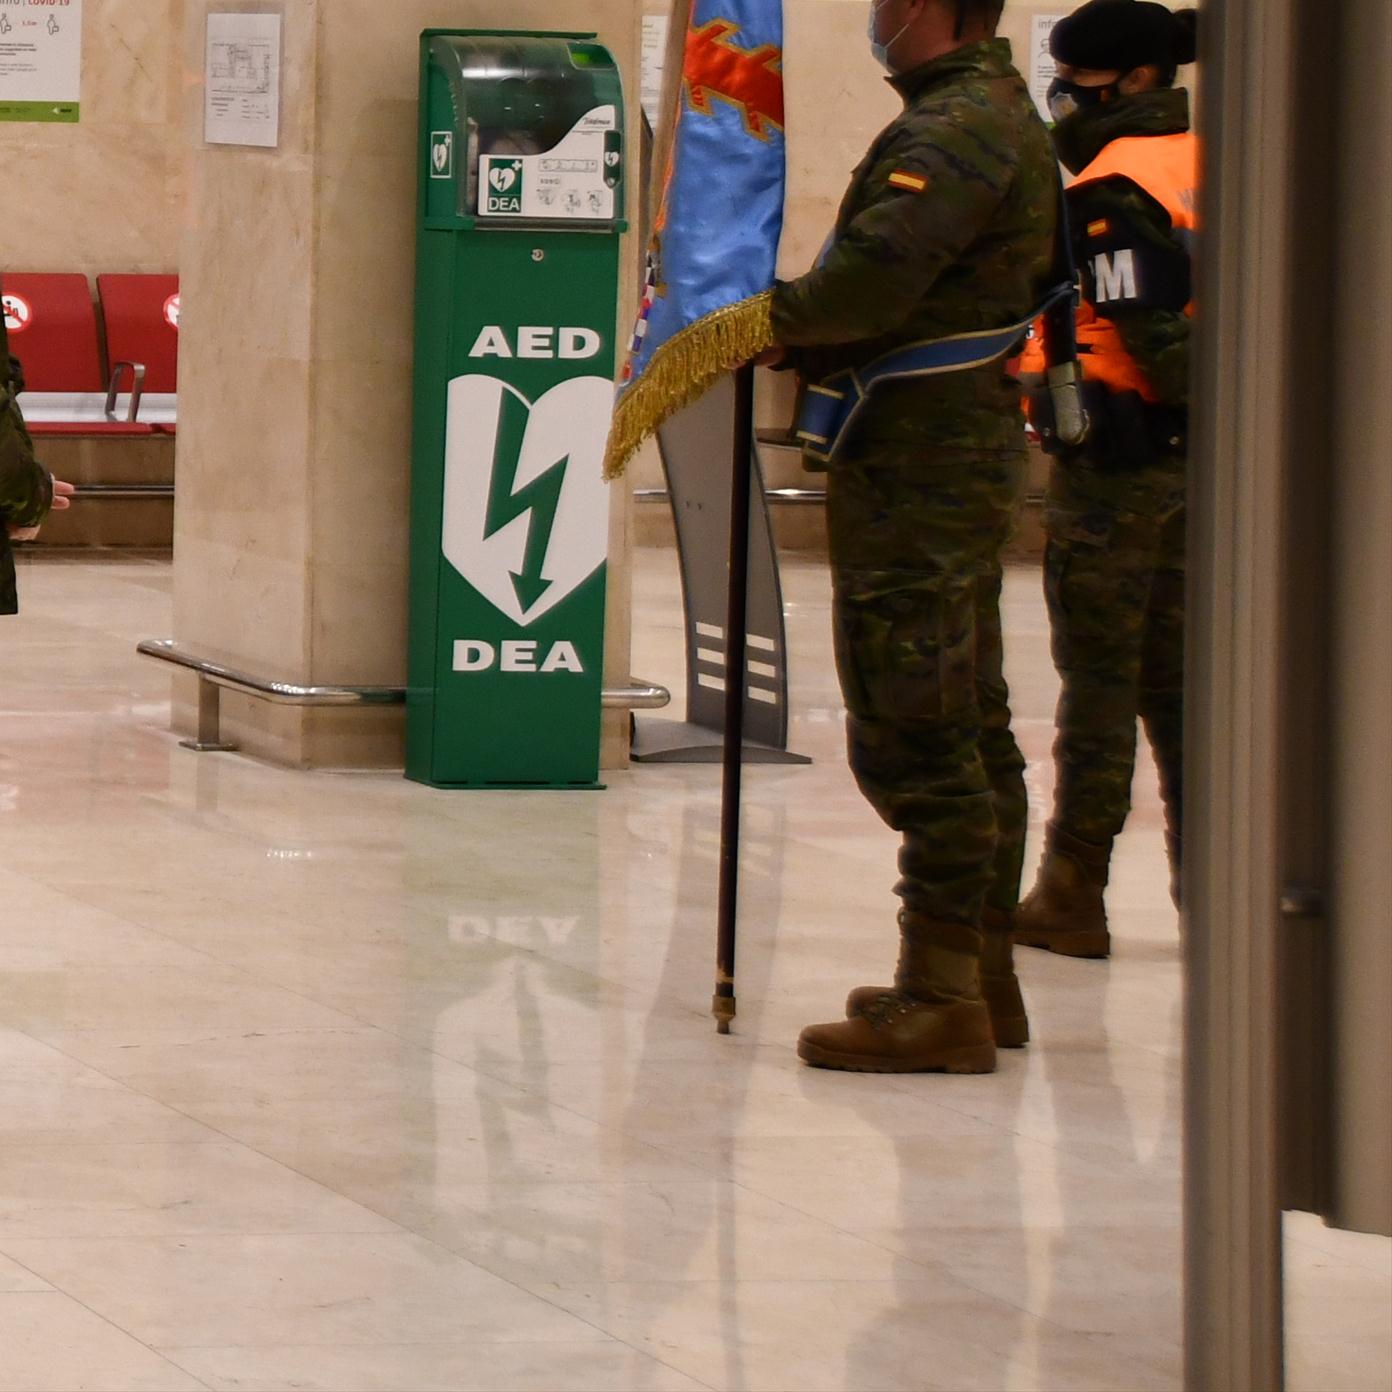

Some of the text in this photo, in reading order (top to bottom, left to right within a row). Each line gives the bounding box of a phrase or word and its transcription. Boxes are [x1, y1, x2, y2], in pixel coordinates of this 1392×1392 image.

[488, 197, 520, 211] DEA
[468, 325, 601, 358] AED
[452, 639, 584, 673] DEA
